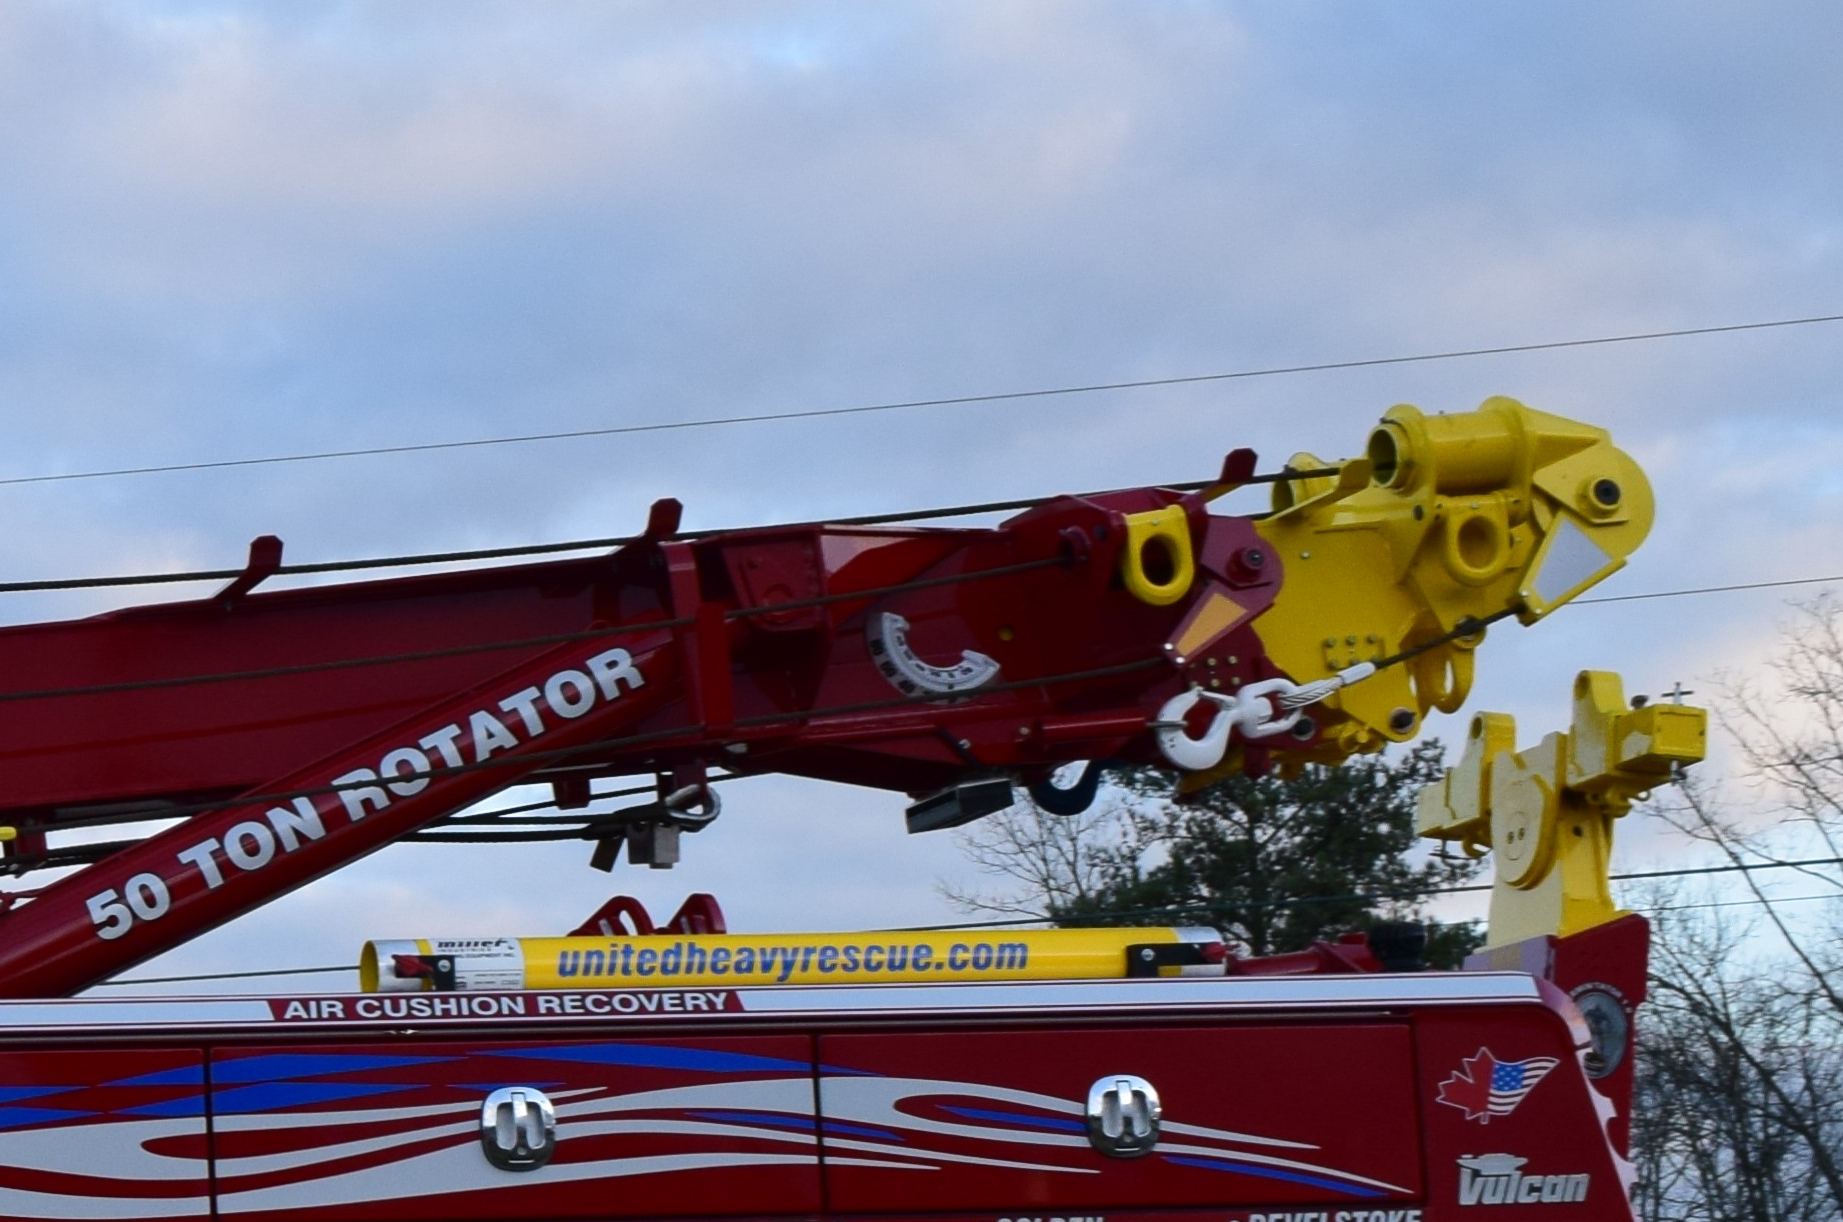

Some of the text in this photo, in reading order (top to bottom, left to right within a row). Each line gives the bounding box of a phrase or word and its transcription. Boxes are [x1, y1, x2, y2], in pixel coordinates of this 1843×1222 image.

[86, 646, 646, 941] 50 TON ROTATOR
[556, 940, 1029, 983] unitedheavyrescue.com
[283, 991, 728, 1020] AIR CUSHION RECOVERY
[1457, 1165, 1591, 1206] Vulcan
